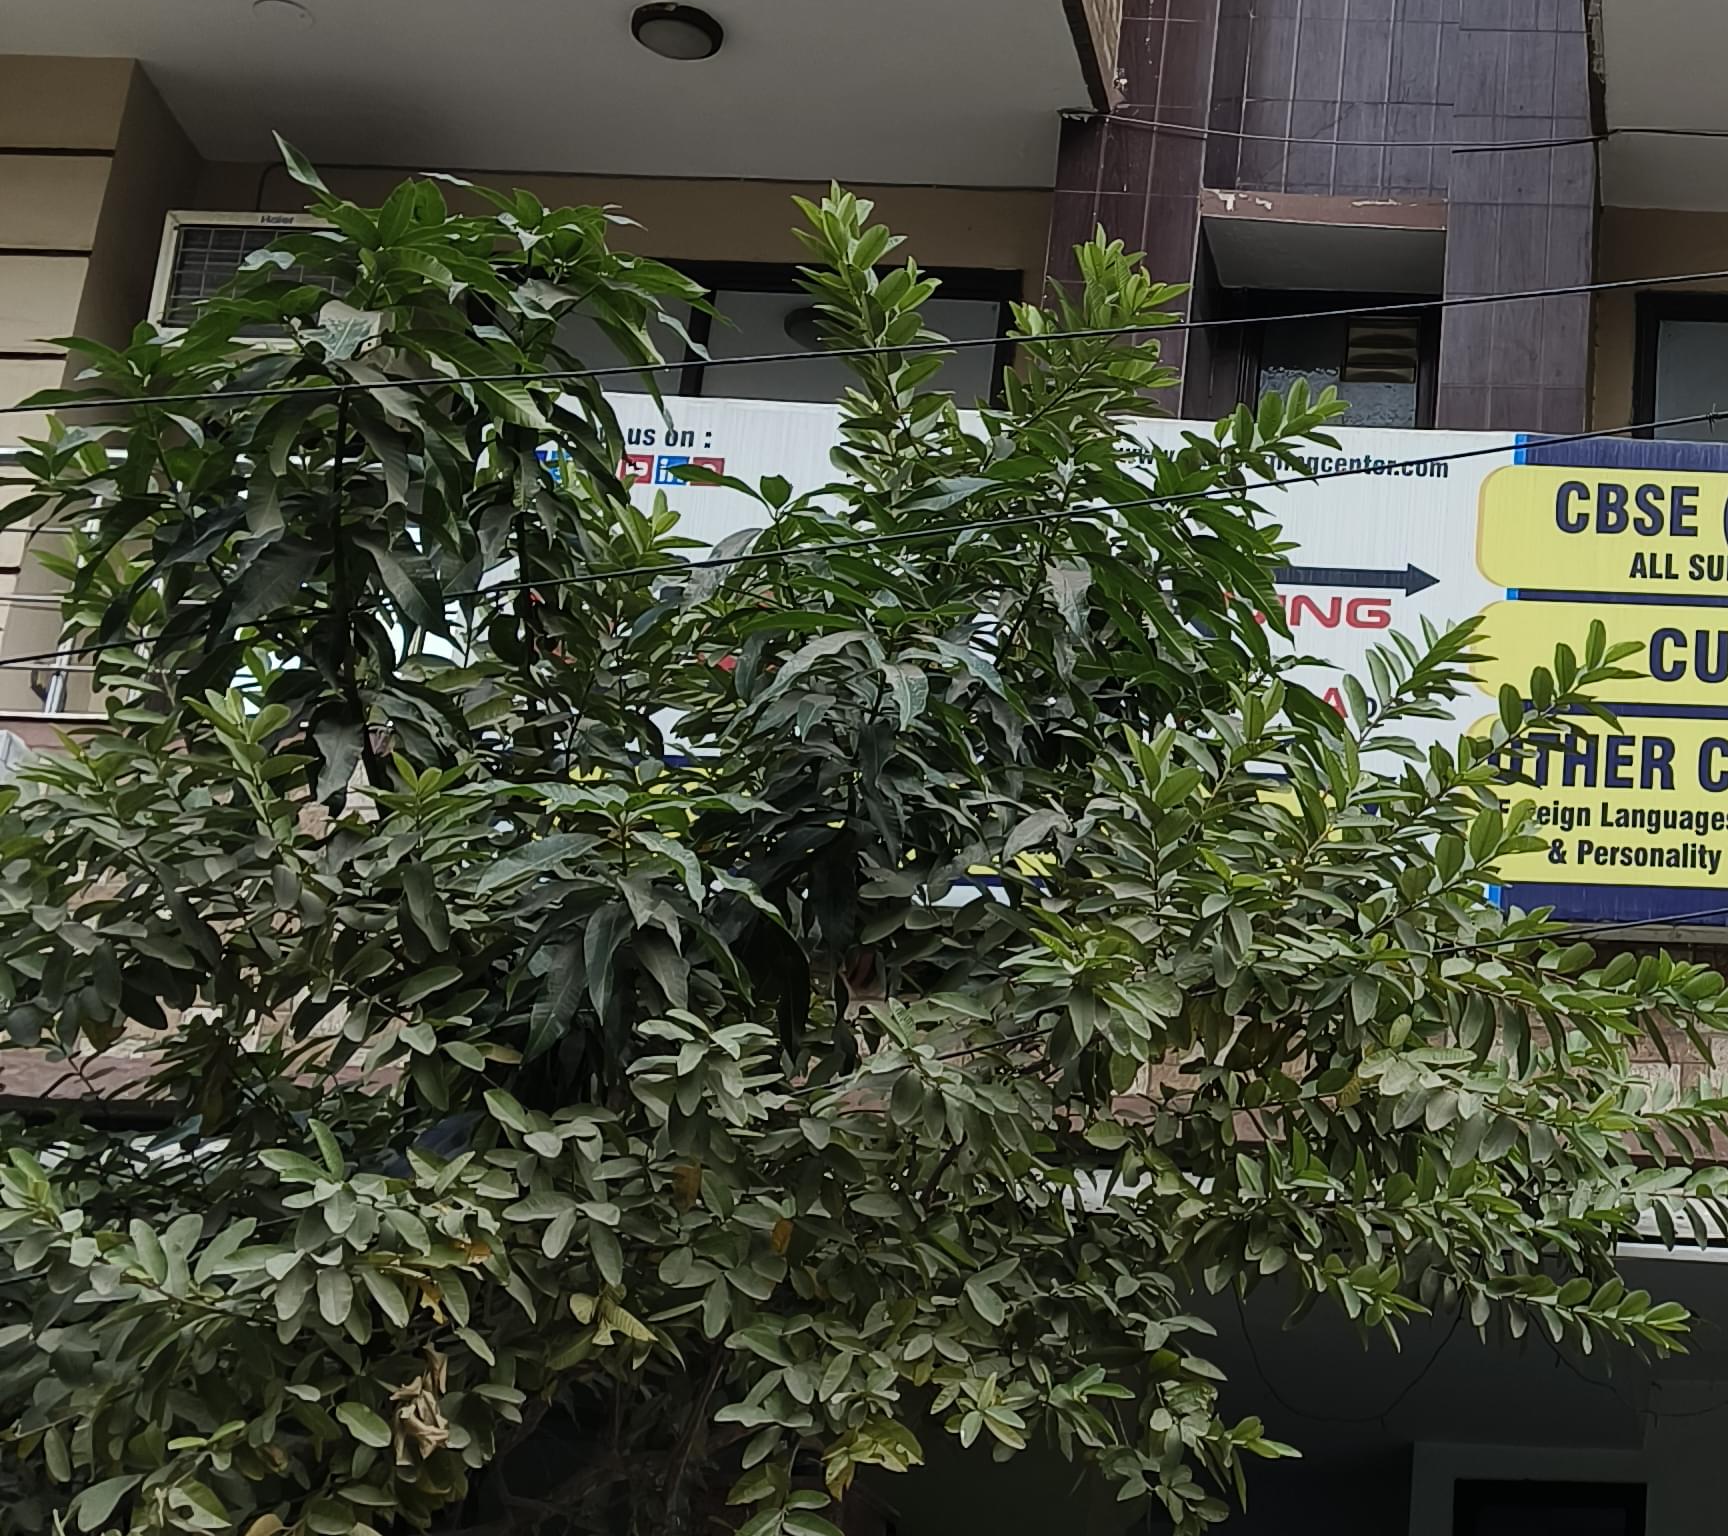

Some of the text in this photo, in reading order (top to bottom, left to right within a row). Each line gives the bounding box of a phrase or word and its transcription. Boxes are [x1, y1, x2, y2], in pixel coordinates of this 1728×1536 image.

[627, 428, 656, 446] us
[665, 429, 695, 447] on
[1556, 480, 1700, 537] CBSE
[1629, 552, 1679, 580] ALL
[1499, 798, 1591, 833] Feign
[1547, 840, 1568, 865] &
[1578, 840, 1722, 875] Personality
